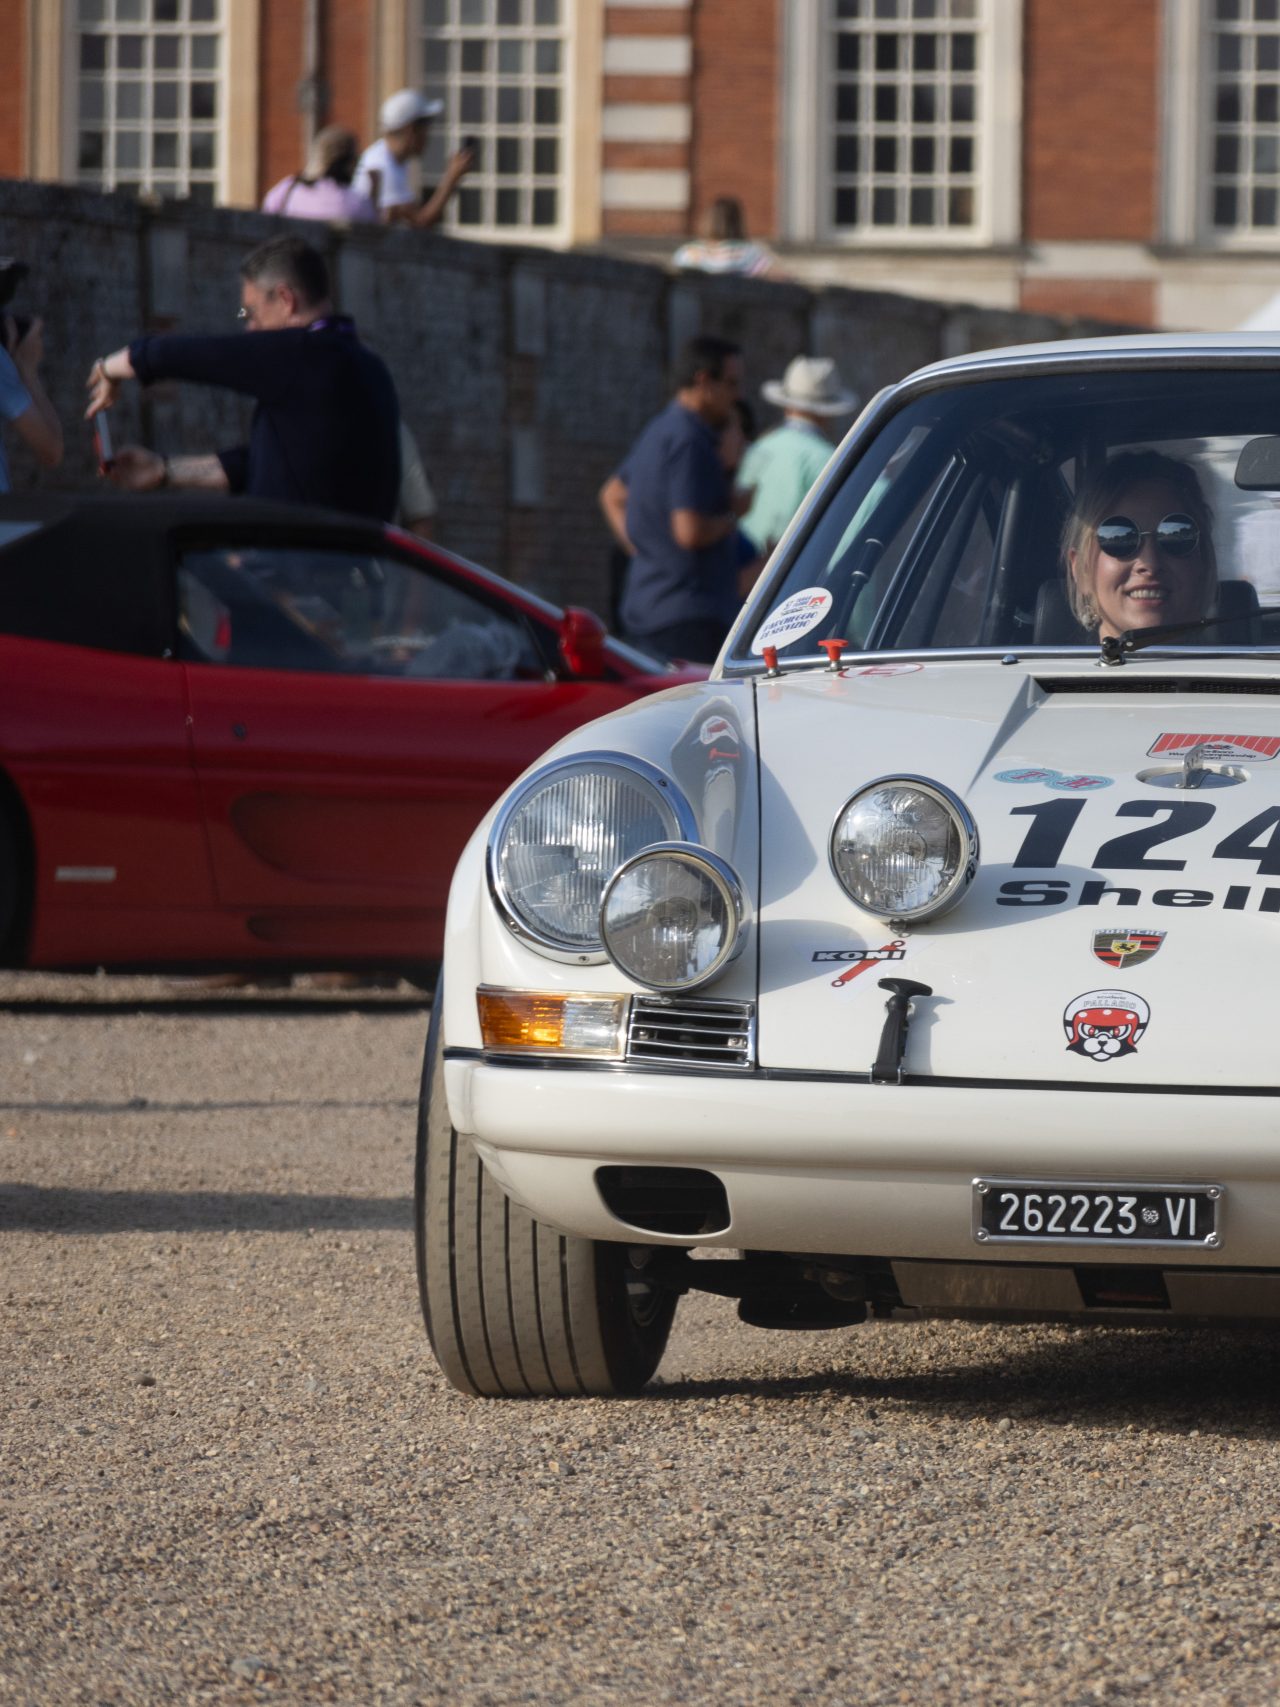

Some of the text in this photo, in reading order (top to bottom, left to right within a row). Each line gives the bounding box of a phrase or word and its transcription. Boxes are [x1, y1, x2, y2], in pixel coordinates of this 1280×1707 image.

[1095, 928, 1165, 938] PORSCHE
[815, 950, 904, 961] KONI
[1083, 1000, 1137, 1009] PALLADIO
[1000, 1192, 1196, 1236] 262223 VI
